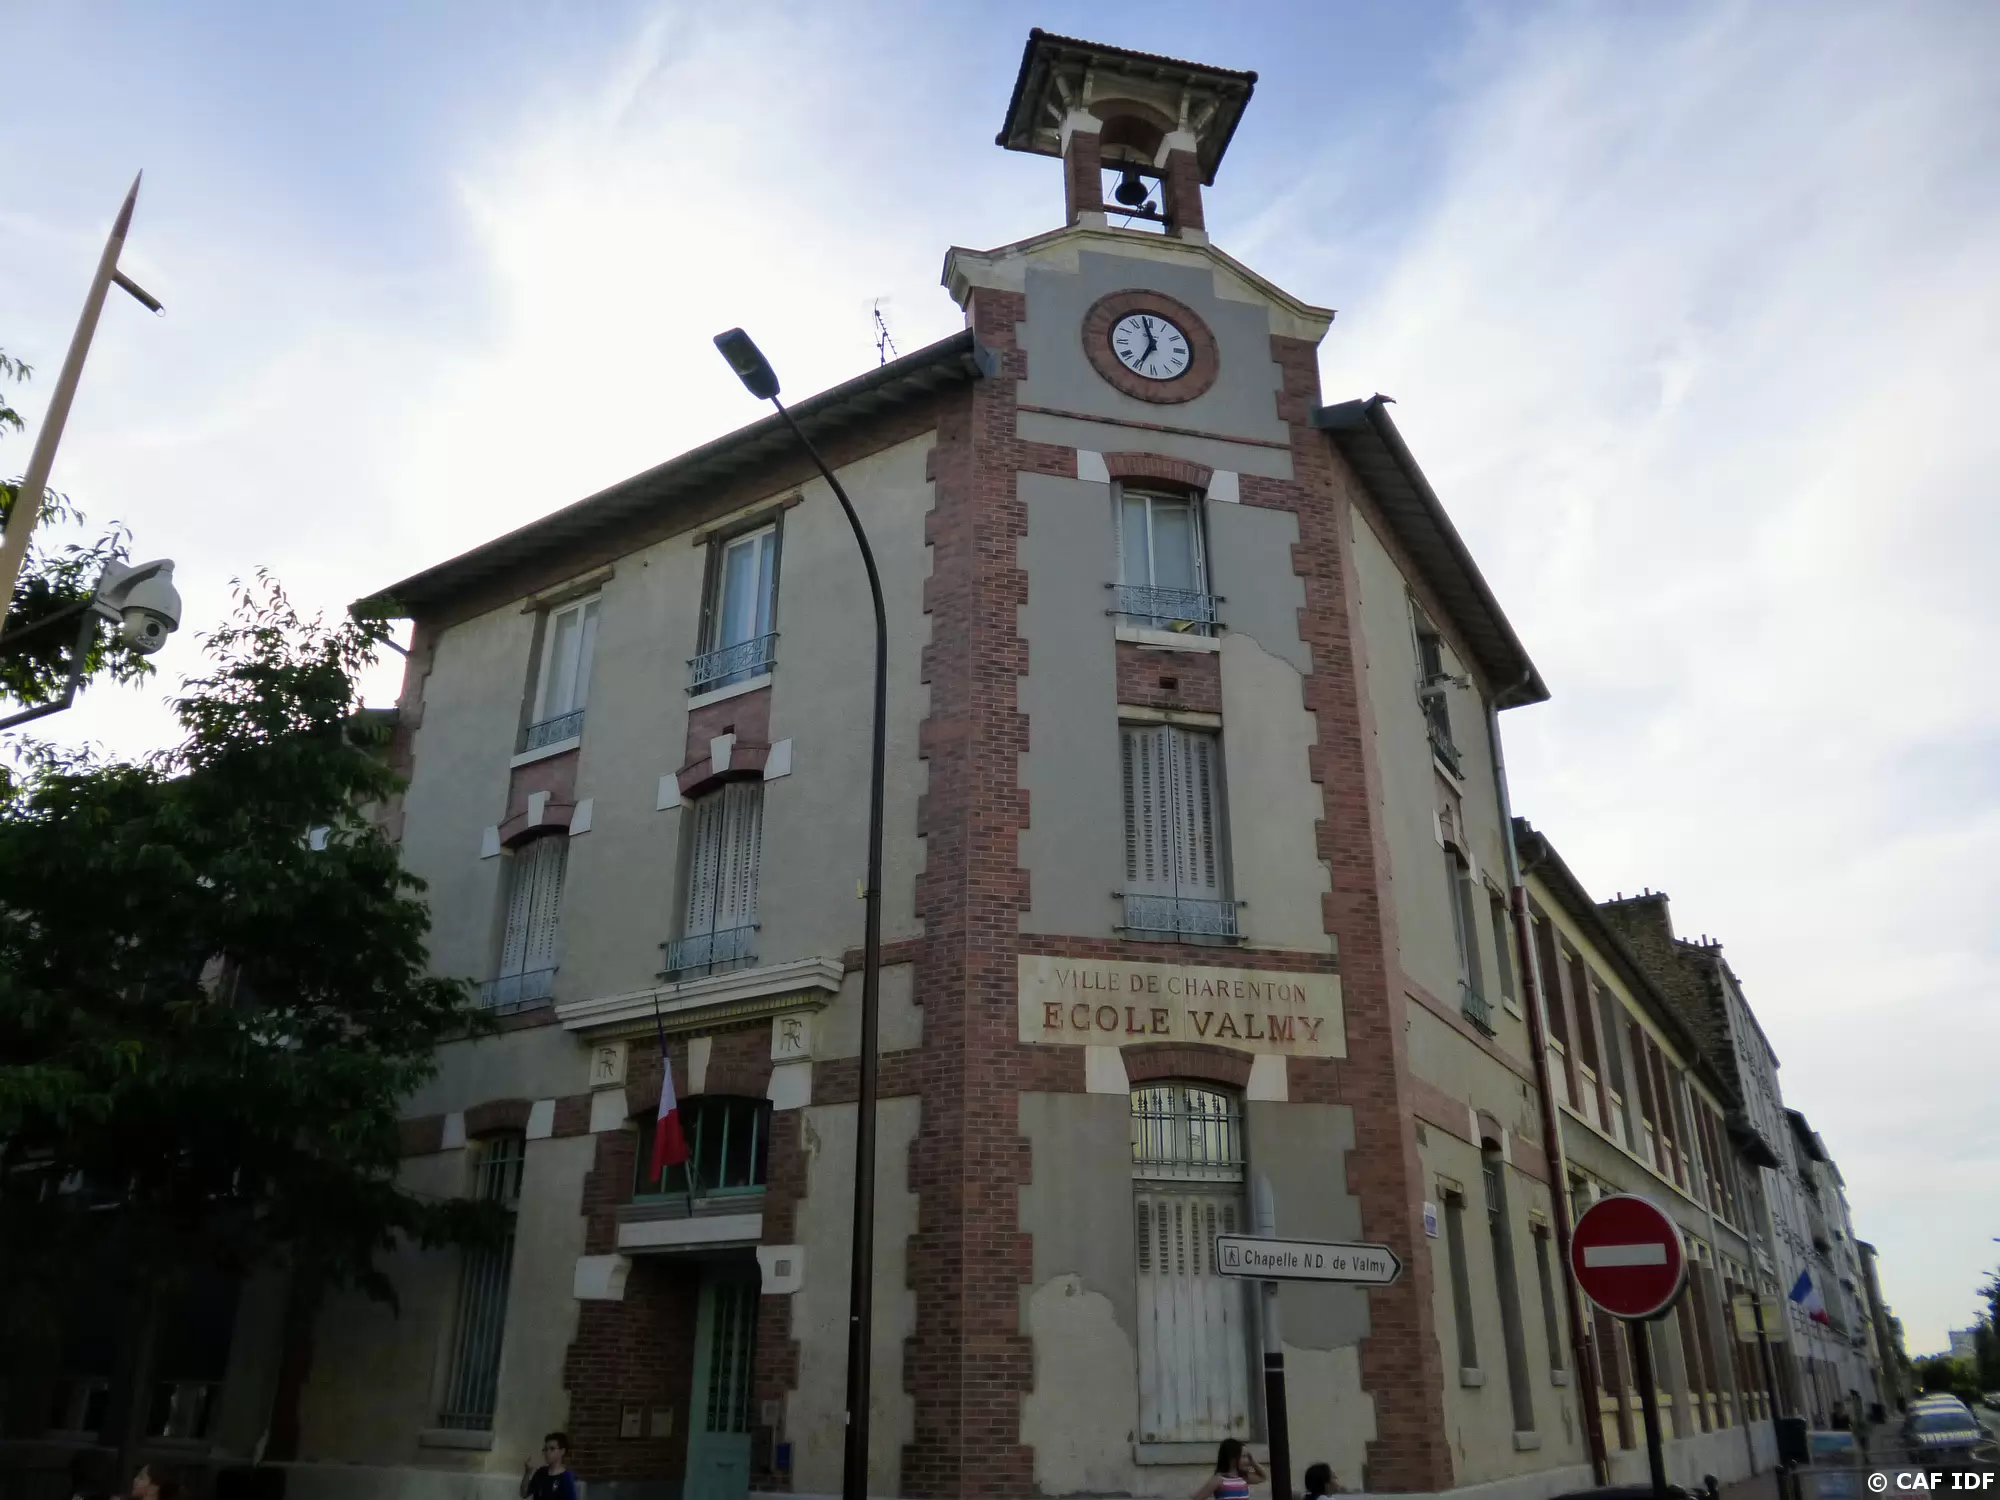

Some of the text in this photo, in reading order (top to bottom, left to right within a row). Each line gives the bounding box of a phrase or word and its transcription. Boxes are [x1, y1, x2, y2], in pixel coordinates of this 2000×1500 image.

[1055, 969, 1307, 1003] VILLE DE CHARENTON
[1042, 1001, 1325, 1042] ECOLE VALMY
[1244, 1249, 1298, 1272] Chapelle
[1333, 1253, 1346, 1270] de
[1352, 1255, 1386, 1274] Valmy
